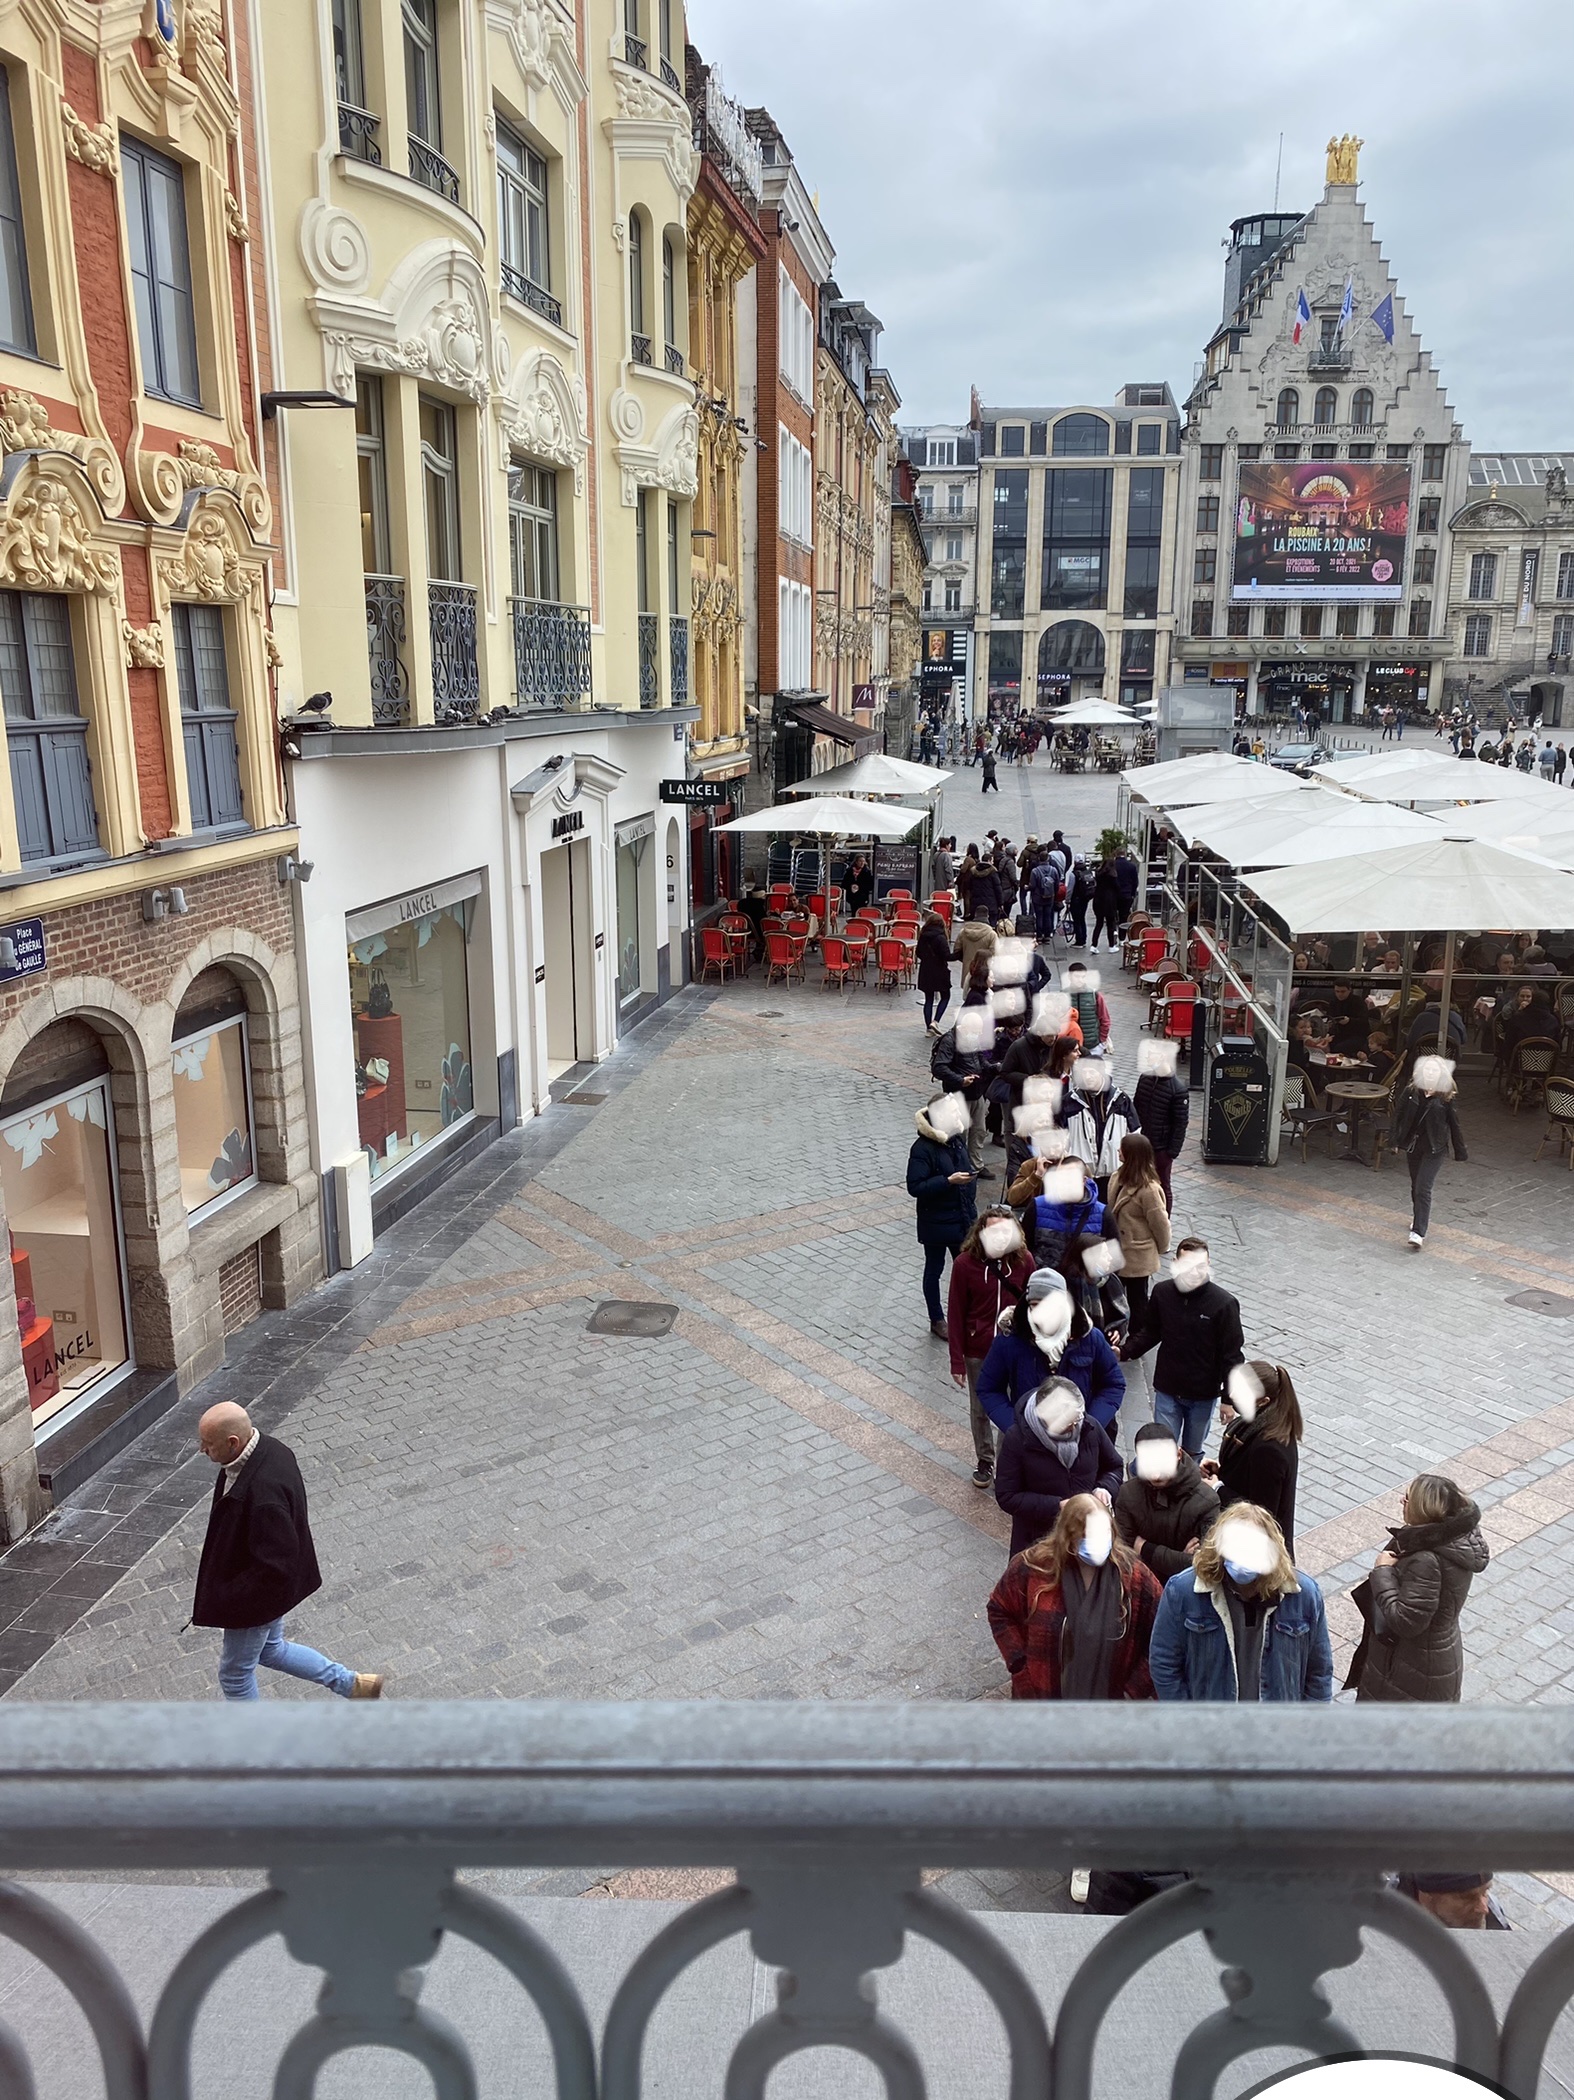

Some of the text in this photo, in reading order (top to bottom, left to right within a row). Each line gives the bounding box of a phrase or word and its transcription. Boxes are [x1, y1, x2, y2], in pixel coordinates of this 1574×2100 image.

[1288, 527, 1318, 537] ROUBAIX
[1273, 538, 1284, 552] LA
[1288, 538, 1322, 552] PISCINE
[1324, 538, 1331, 552] A
[1332, 538, 1345, 552] 20
[1346, 538, 1366, 552] ANS
[1286, 558, 1315, 566] EXPOSITIONS
[1523, 582, 1530, 592] DU
[1209, 643, 1433, 656] LA VOIX DU NORD
[668, 784, 720, 796] LANCEL
[630, 824, 646, 840] LANCEL
[400, 893, 437, 921] LANCEL
[16, 928, 32, 938] Place
[22, 954, 42, 968] GAULLE
[34, 1330, 94, 1385] LANCEL
